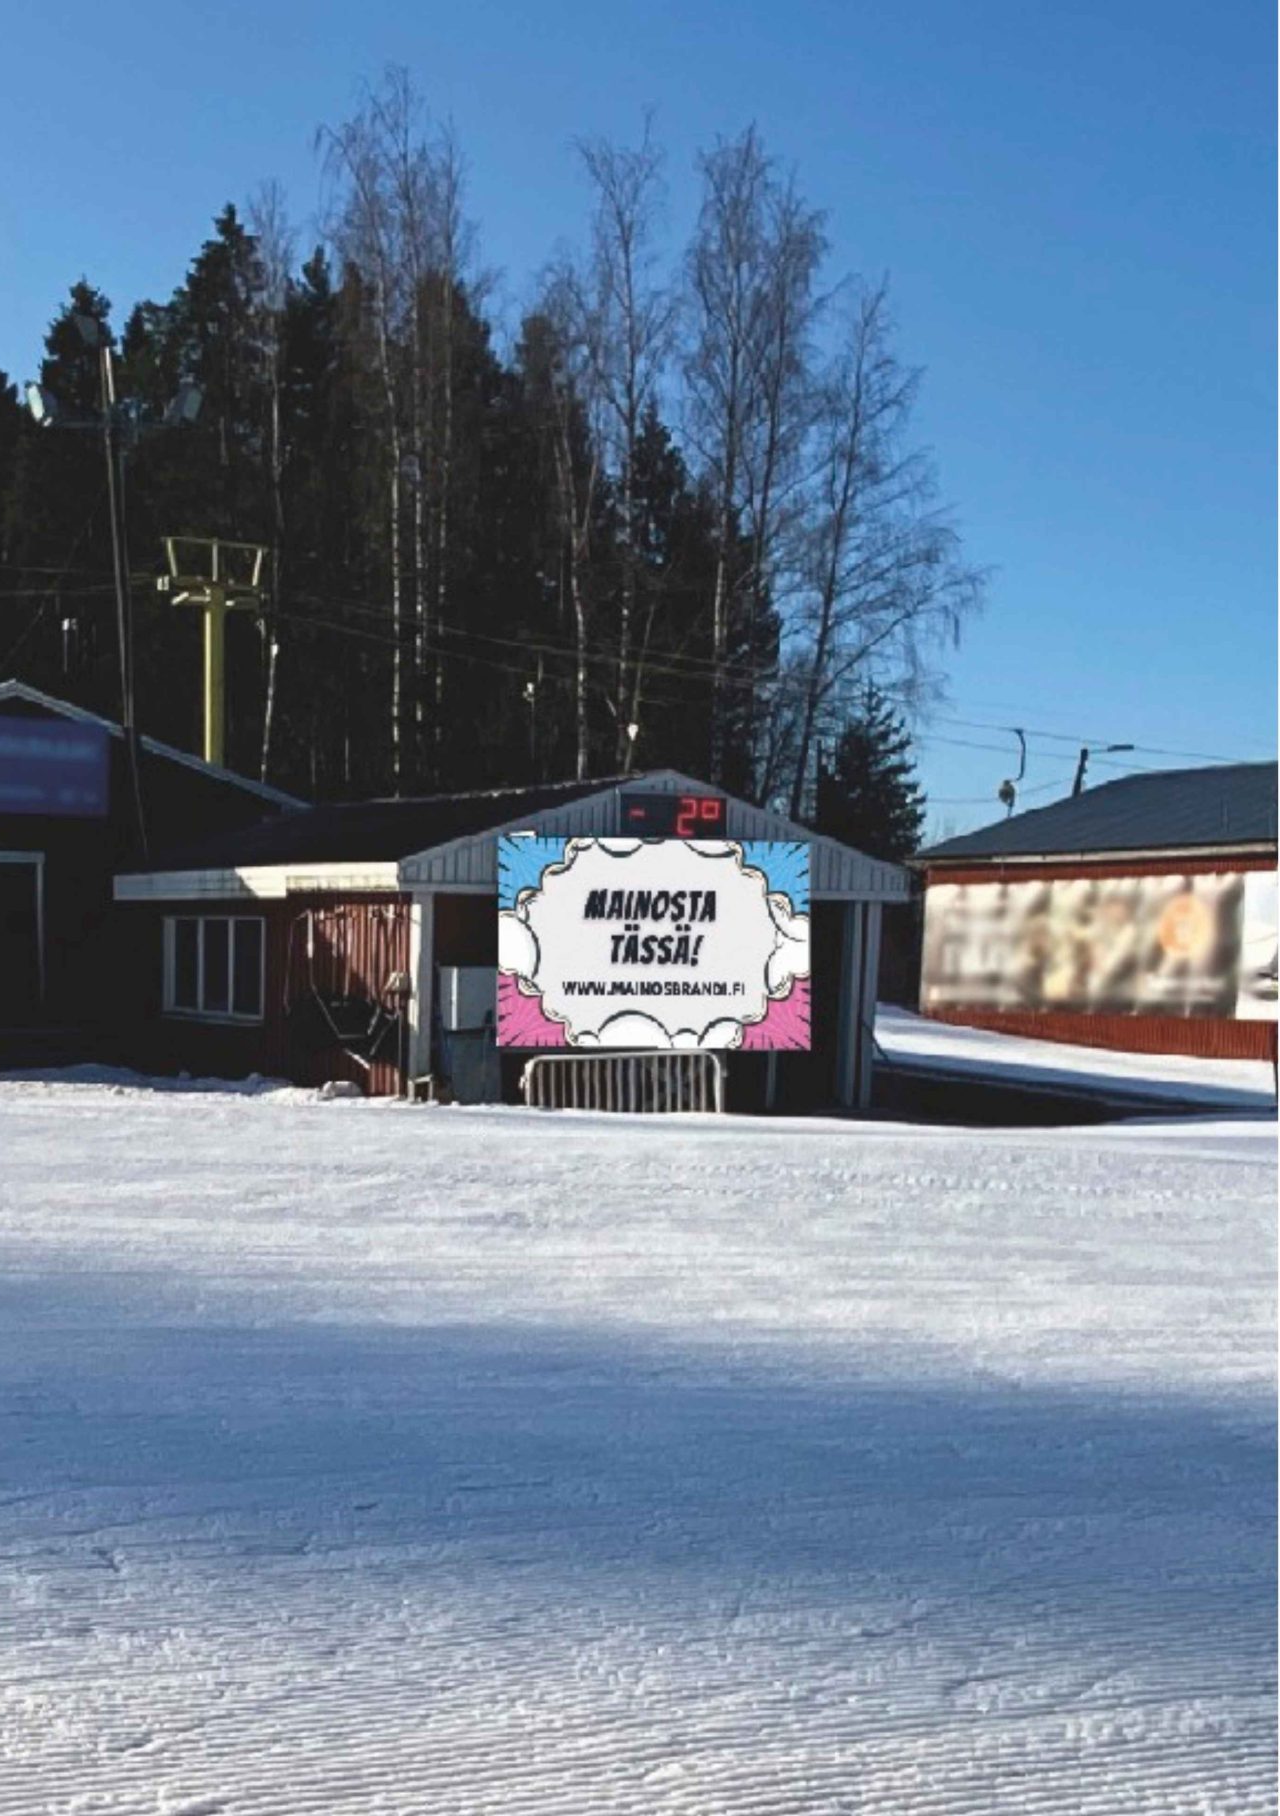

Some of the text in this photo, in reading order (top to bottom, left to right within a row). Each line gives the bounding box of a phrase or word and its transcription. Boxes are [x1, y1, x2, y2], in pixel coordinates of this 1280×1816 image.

[583, 888, 718, 923] MAINOSTA
[609, 923, 706, 967] TÄSSÄ!
[562, 981, 746, 997] WWW.MAINOSBRANDI.FI
